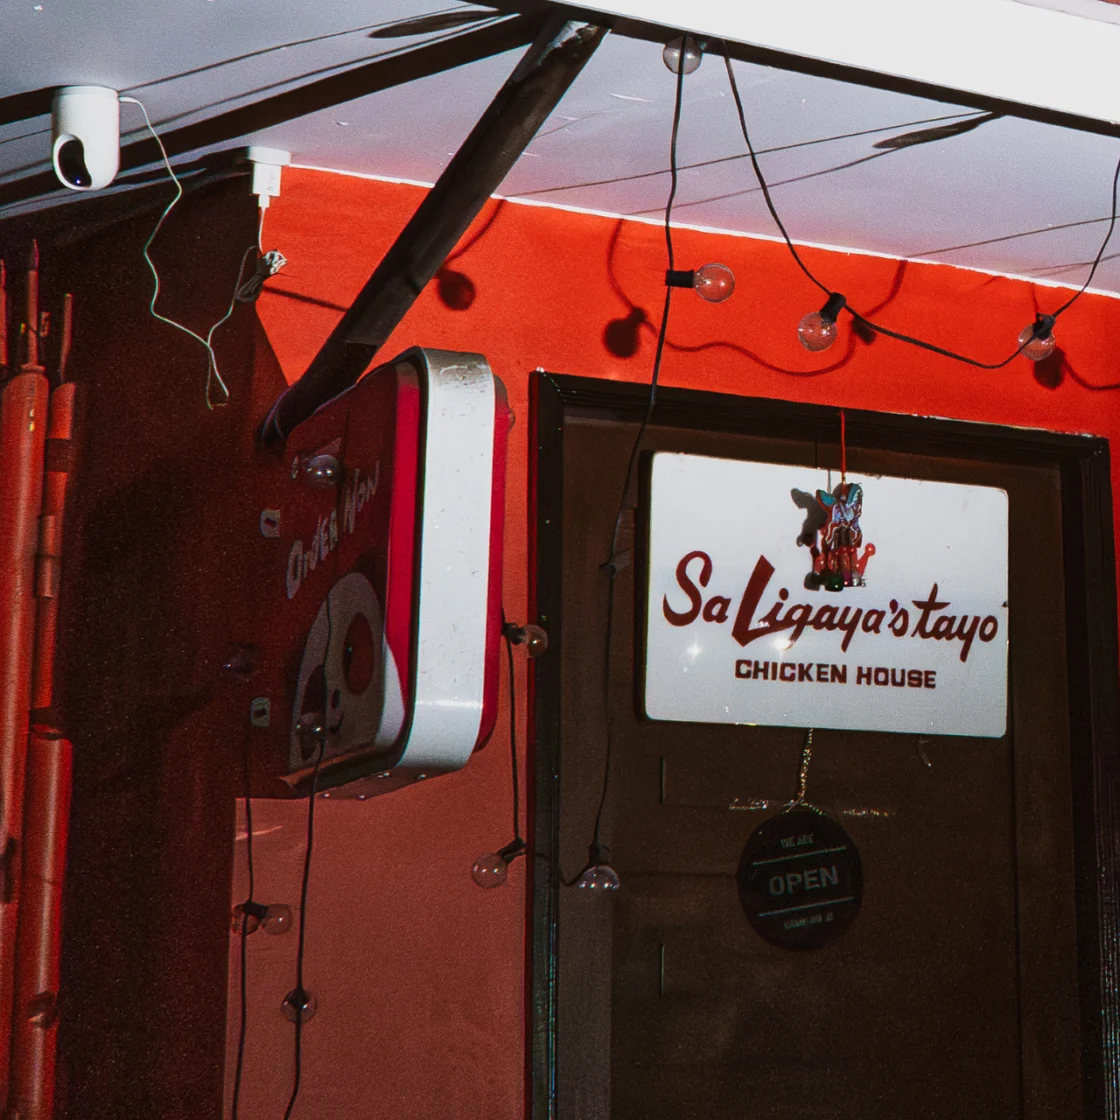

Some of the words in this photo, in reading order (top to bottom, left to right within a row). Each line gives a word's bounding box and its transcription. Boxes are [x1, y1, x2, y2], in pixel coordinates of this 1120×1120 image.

[662, 550, 732, 627] Sa
[911, 582, 999, 663] tayo
[734, 659, 848, 686] CHICKEN
[856, 665, 937, 689] HOUSE
[768, 865, 839, 896] OPEN
